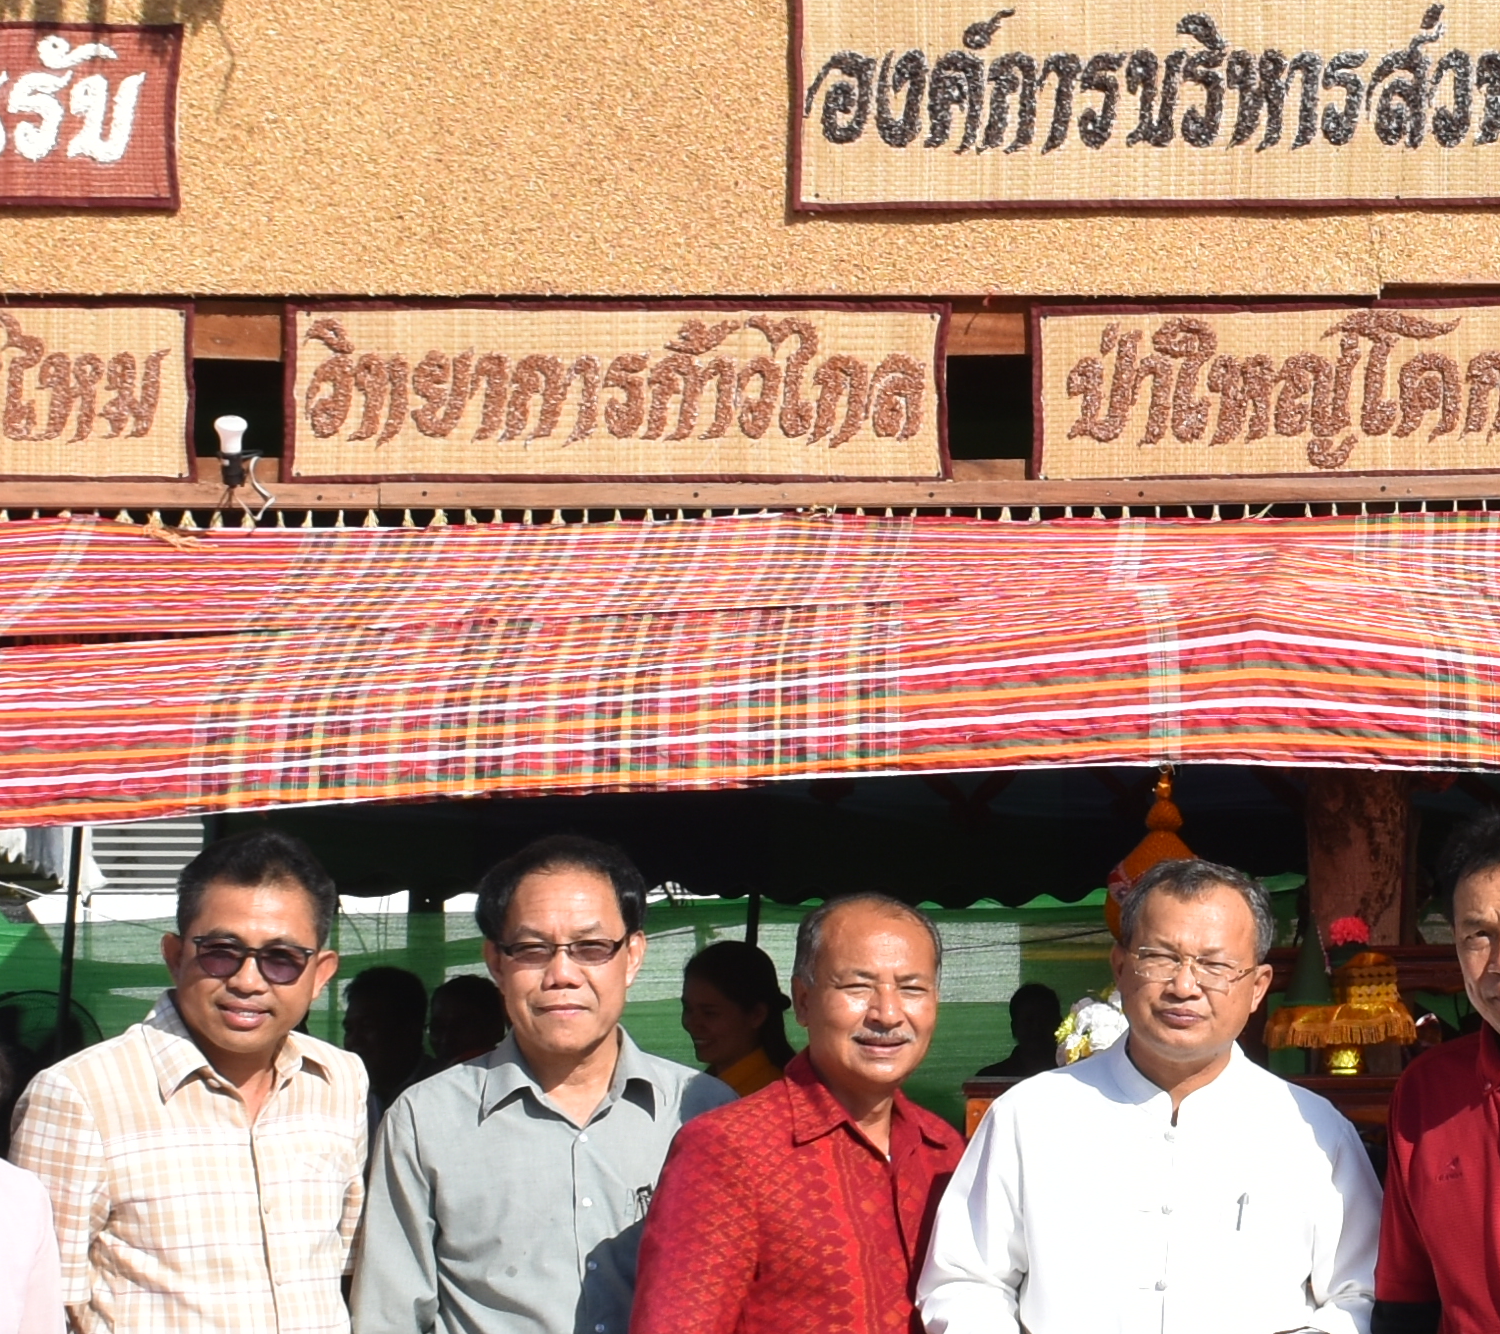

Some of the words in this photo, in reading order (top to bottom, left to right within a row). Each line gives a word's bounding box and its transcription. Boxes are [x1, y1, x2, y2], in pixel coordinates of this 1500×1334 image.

[304, 314, 926, 449] วิทยาการก้าวไกล
